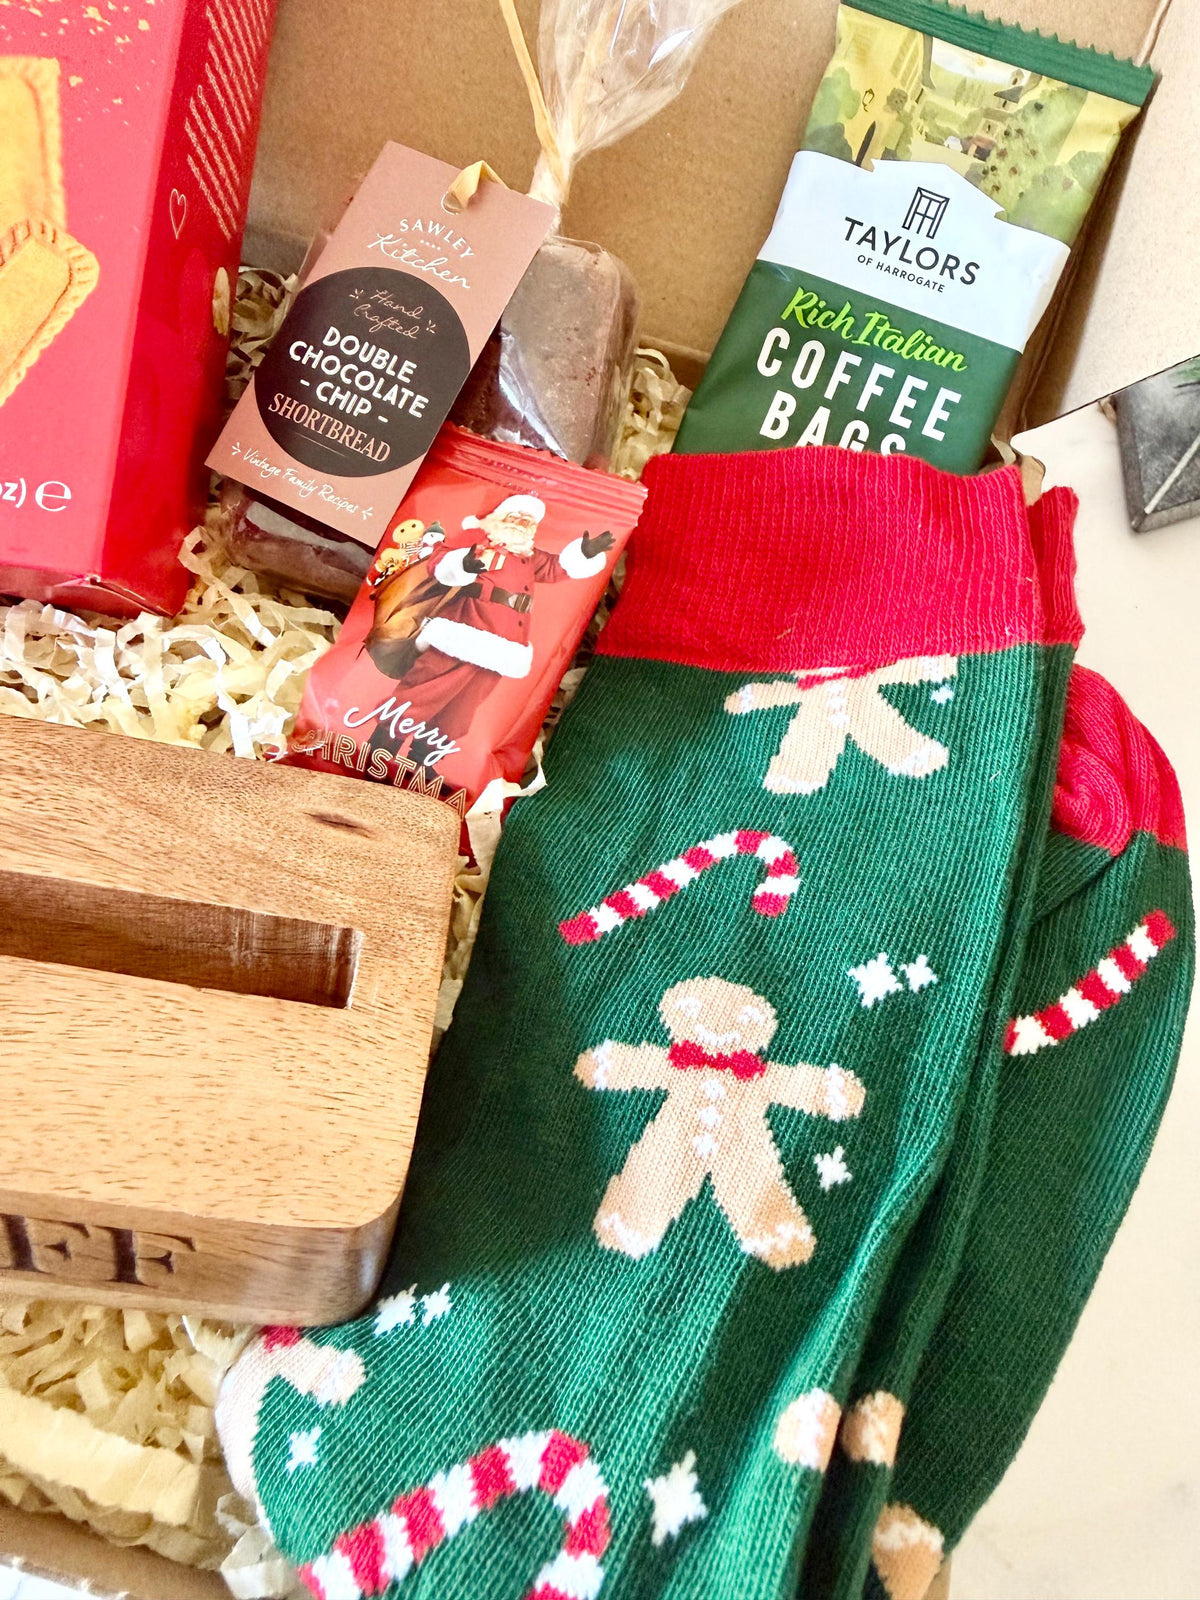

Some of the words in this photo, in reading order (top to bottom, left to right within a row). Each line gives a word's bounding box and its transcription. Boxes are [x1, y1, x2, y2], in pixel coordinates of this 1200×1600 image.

[367, 232, 471, 289] Kitchen
[399, 218, 475, 259] SAWLEY
[844, 216, 981, 287] TAYLORS
[857, 254, 874, 267] OF
[876, 262, 945, 293] HARROGATE
[353, 303, 420, 339] Crafted
[369, 289, 424, 319] Hand
[781, 287, 854, 341] Rich
[852, 311, 967, 373] Italian
[288, 340, 429, 418] CHOCOLATE
[322, 326, 418, 384] DOUBLE
[756, 327, 962, 441] COFFEE
[268, 391, 392, 464] SHORTBREAD
[315, 381, 373, 417] CHIP
[0, 477, 27, 508] z)
[243, 448, 282, 478] Vintage
[282, 468, 318, 498] Family
[318, 484, 359, 514] Recipes
[343, 696, 461, 767] Merry
